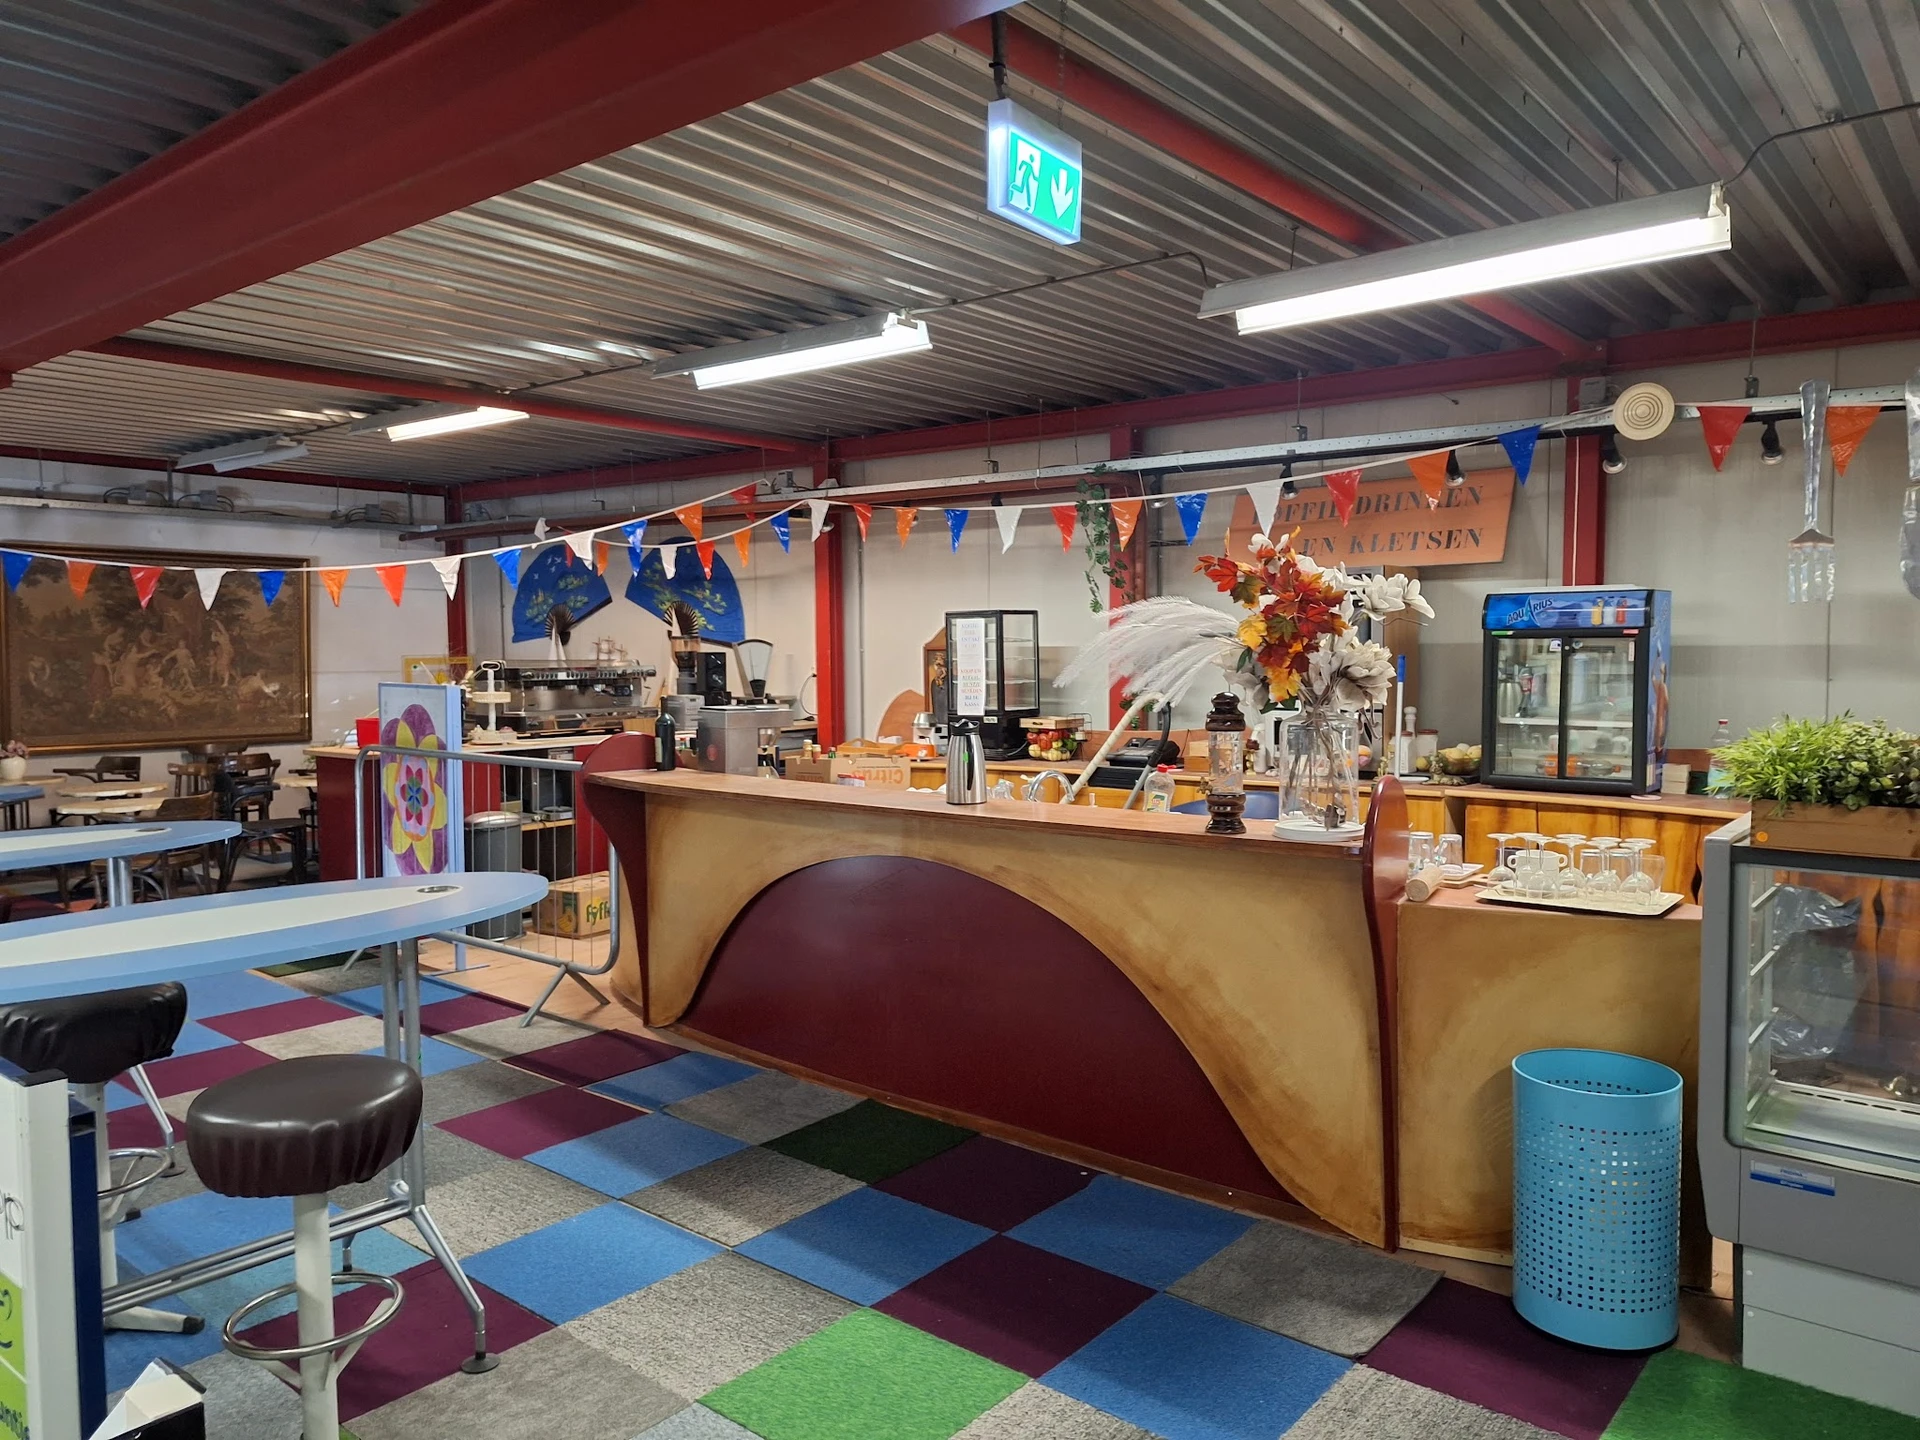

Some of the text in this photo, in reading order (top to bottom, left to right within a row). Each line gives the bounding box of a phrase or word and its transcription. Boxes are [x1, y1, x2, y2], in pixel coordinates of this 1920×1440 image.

[1252, 485, 1484, 525] FFI DRINEN
[1303, 527, 1484, 557] EN KLETSEN
[1507, 596, 1553, 626] AQUARIUS
